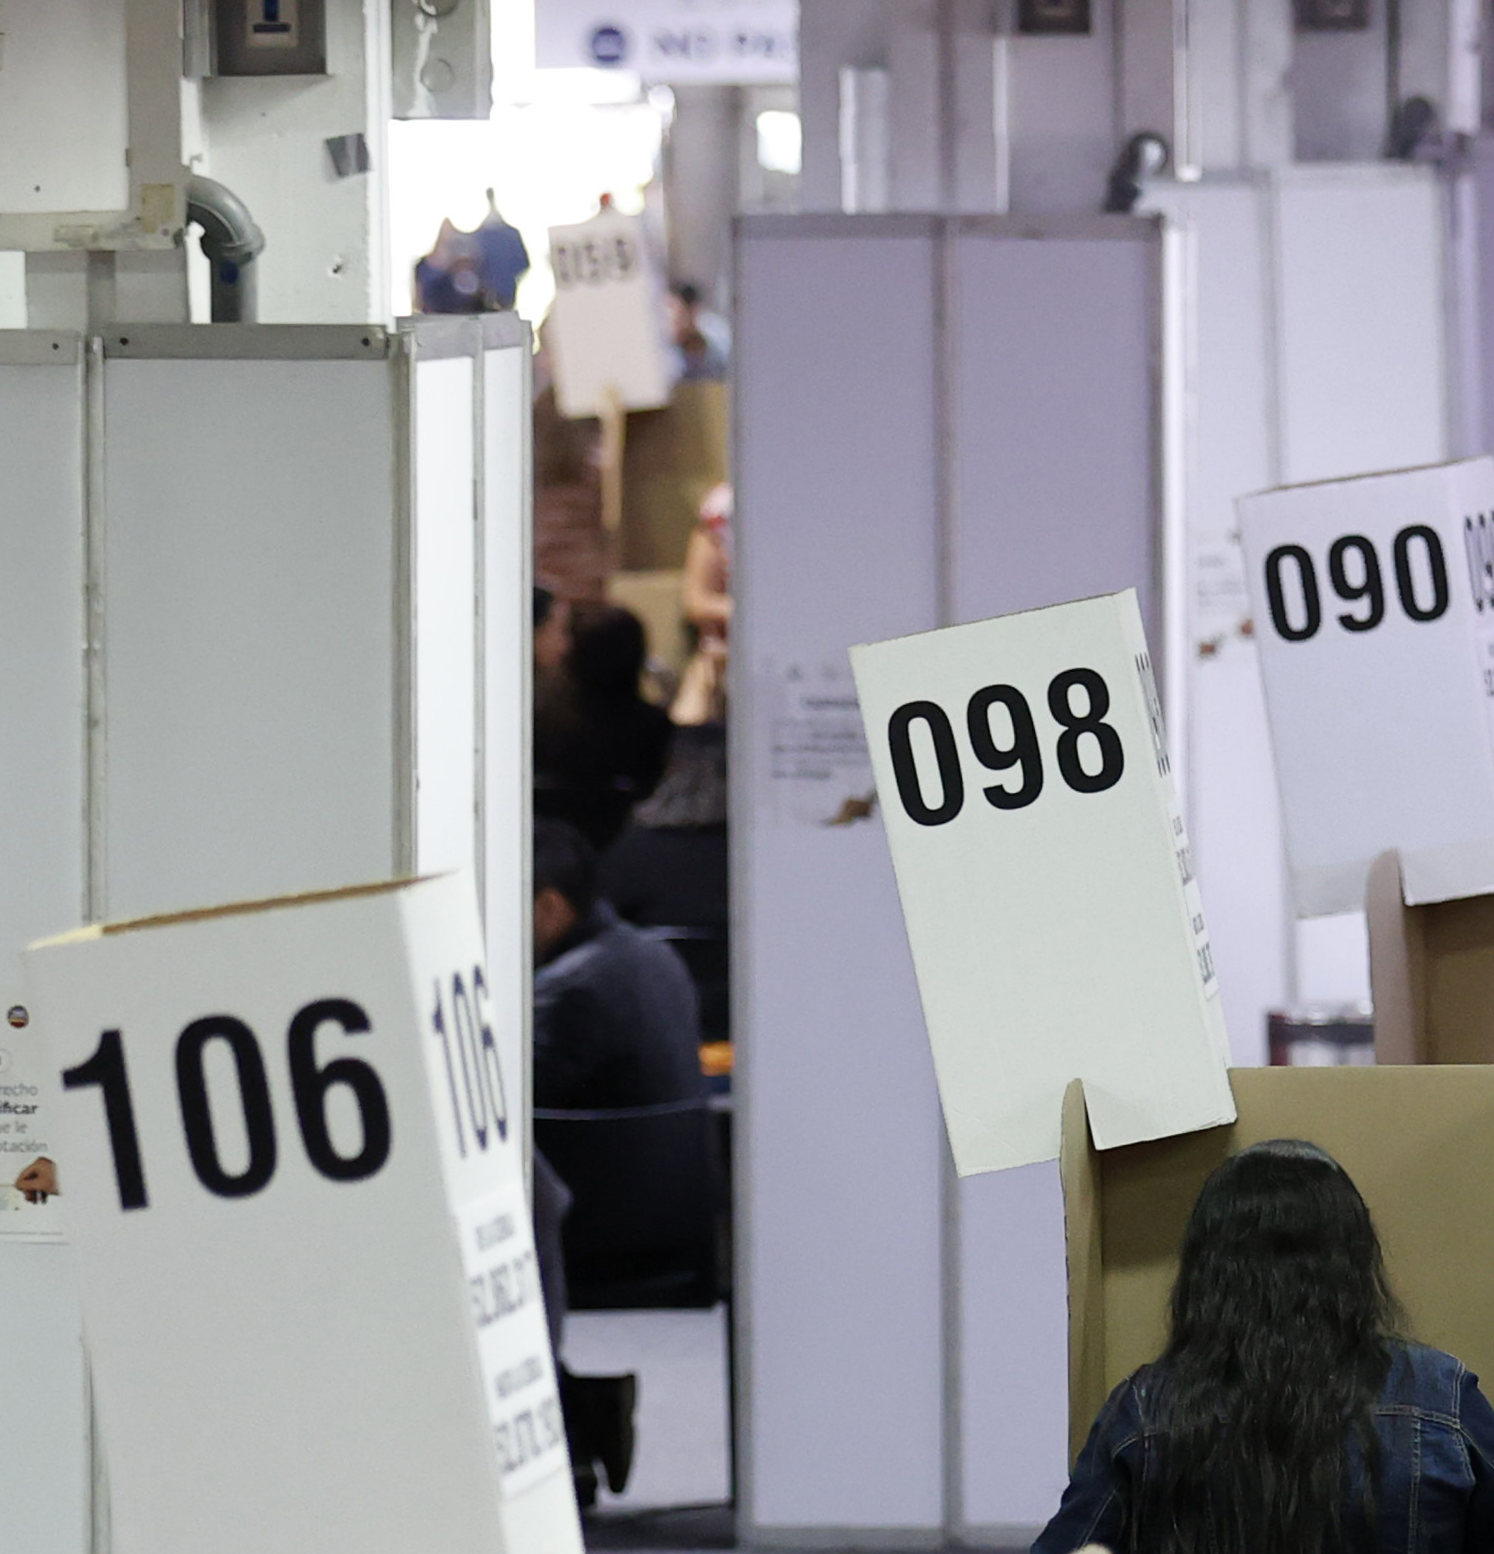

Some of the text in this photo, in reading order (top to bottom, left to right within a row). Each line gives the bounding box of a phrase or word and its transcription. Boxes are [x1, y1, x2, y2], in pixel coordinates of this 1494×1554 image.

[1264, 525, 1449, 643] 090
[886, 667, 1125, 827] 098
[62, 998, 391, 1212] 106
[432, 964, 509, 1159] 106
